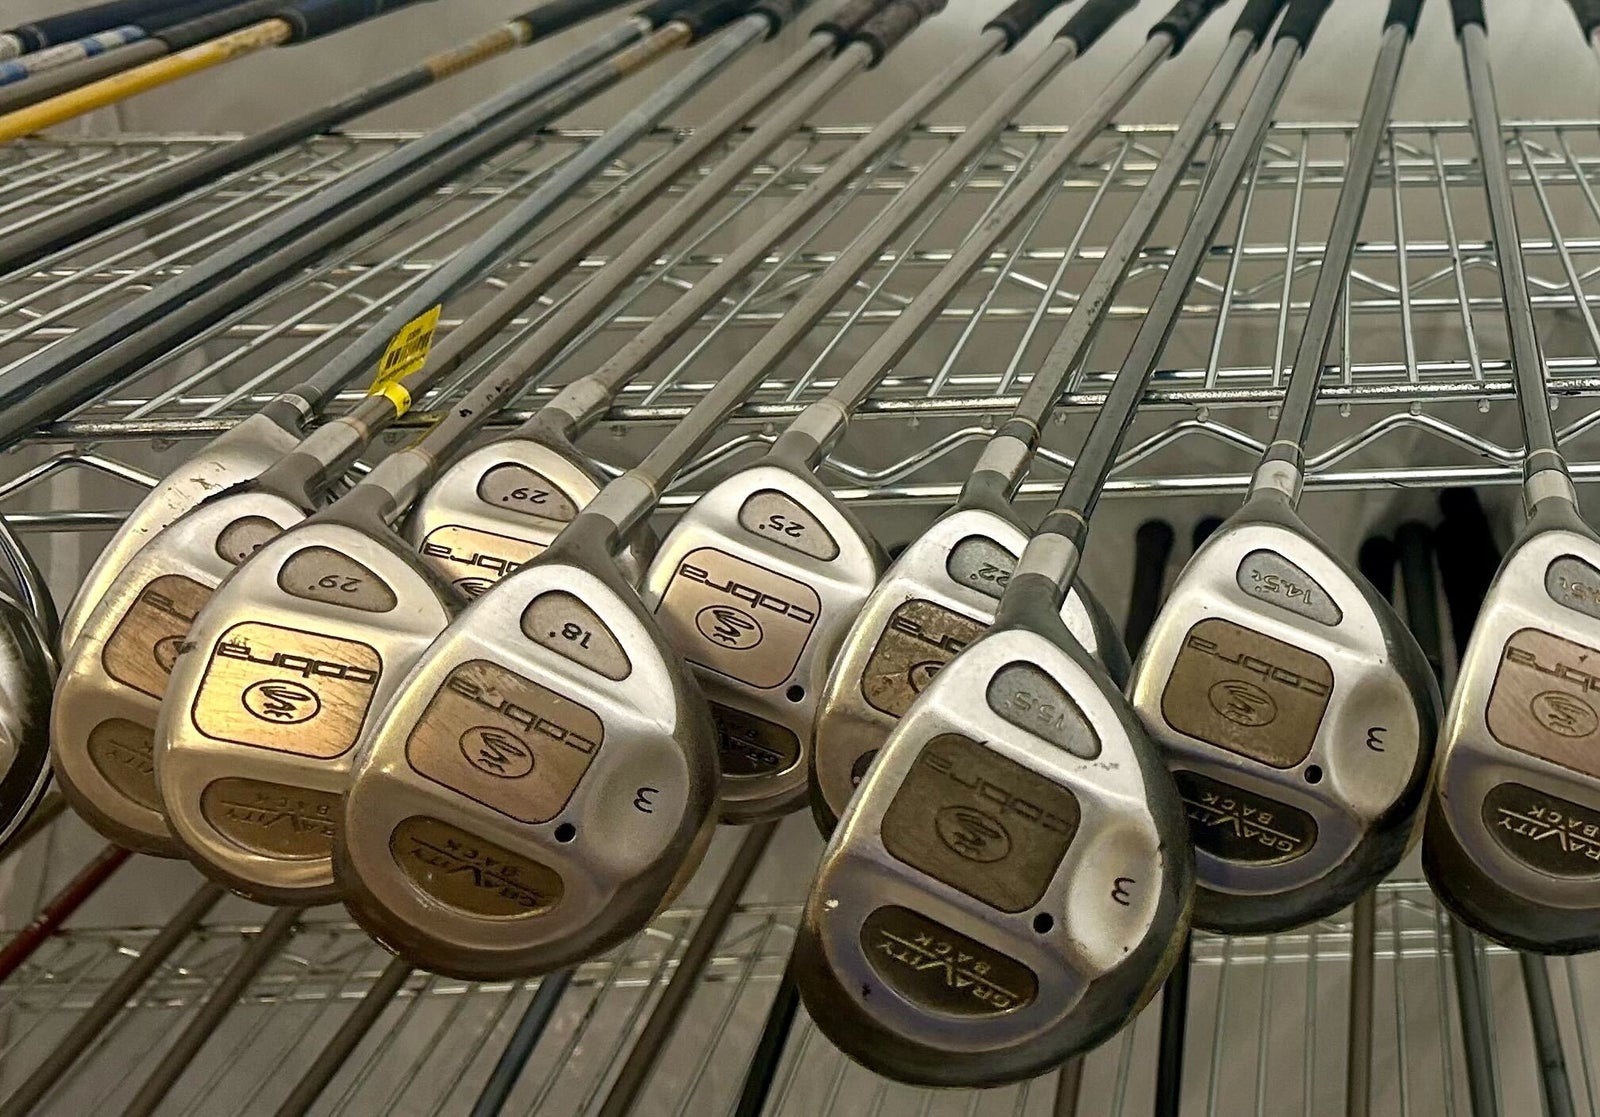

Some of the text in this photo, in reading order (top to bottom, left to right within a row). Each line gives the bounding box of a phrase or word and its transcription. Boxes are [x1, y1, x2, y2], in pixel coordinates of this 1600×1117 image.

[424, 543, 521, 574] bra
[681, 563, 814, 625] cobra
[218, 641, 379, 684] cobra
[1187, 636, 1327, 699] cobra
[447, 676, 597, 754] cobra
[1366, 727, 1386, 752] 3
[633, 788, 659, 814] 3
[922, 752, 1072, 838] cobra
[1203, 794, 1271, 825] BACK
[1193, 813, 1291, 855] GRAVIT
[1526, 805, 1599, 837] BACK
[408, 846, 538, 909] GRAVITY
[447, 838, 519, 876] BACK
[1112, 876, 1136, 905] 3
[913, 930, 989, 973] BACK
[879, 940, 1019, 1011] GRAVITY
